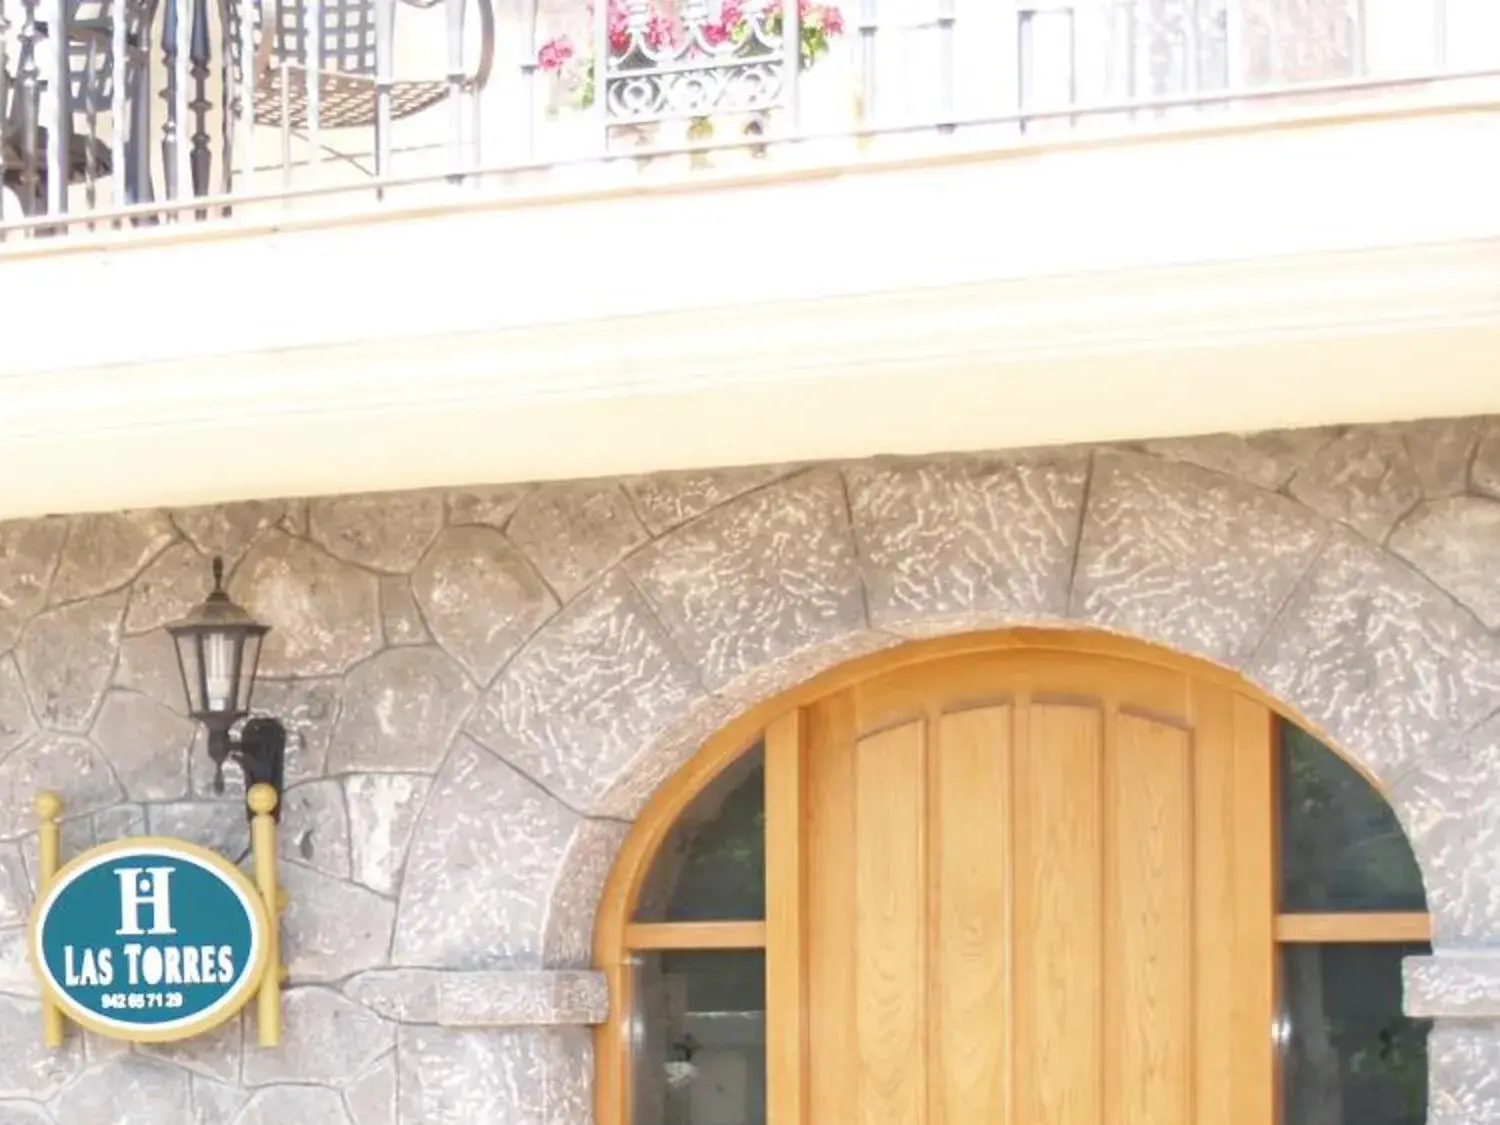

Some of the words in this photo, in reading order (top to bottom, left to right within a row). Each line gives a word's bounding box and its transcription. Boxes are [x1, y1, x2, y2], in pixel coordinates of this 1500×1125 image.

[113, 866, 177, 935] H
[63, 945, 113, 987] LAS
[123, 943, 235, 986] TORRES
